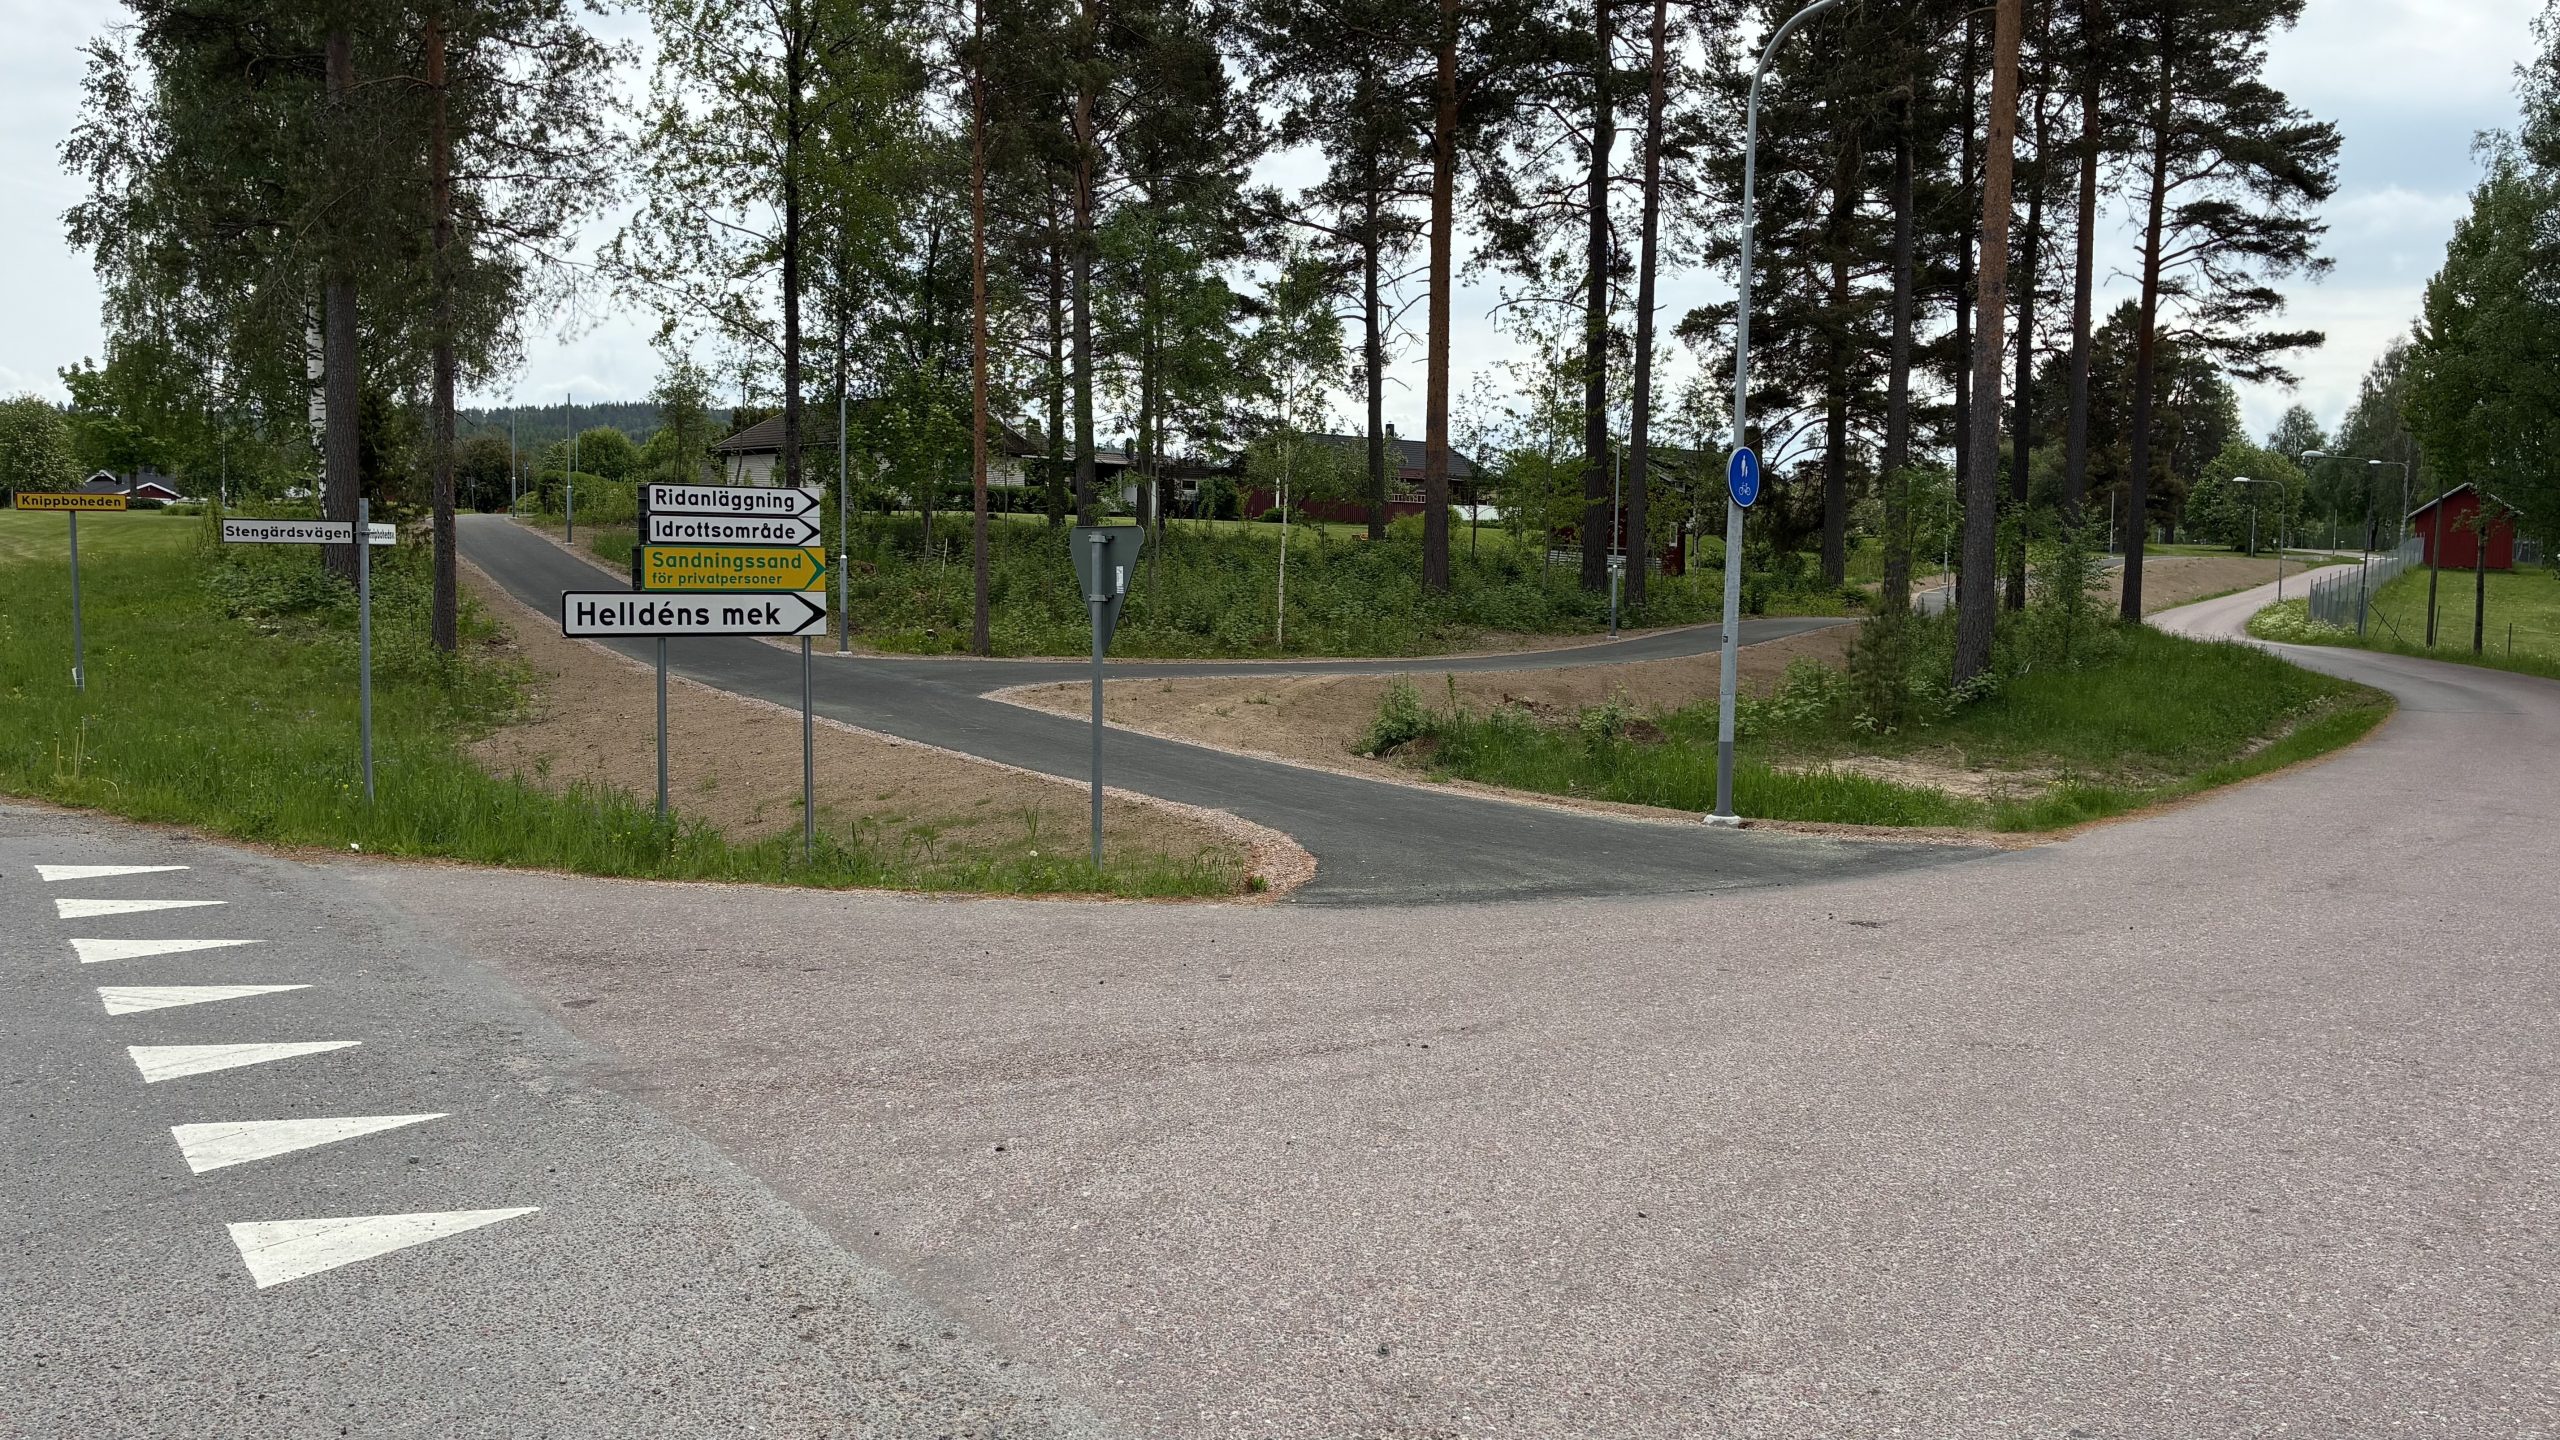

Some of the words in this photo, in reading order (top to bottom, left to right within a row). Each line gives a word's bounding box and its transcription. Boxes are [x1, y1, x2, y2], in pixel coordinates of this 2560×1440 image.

[21, 495, 121, 508] Knippboheden
[655, 488, 795, 512] Ridanläggning
[225, 525, 351, 541] Stengärdsvägen
[655, 519, 796, 539] Idrottsområde
[652, 551, 802, 572] Sandningssand
[652, 572, 674, 584] för
[678, 573, 782, 587] privatpersoner
[576, 601, 709, 626] Helldéns
[722, 602, 781, 626] mek
